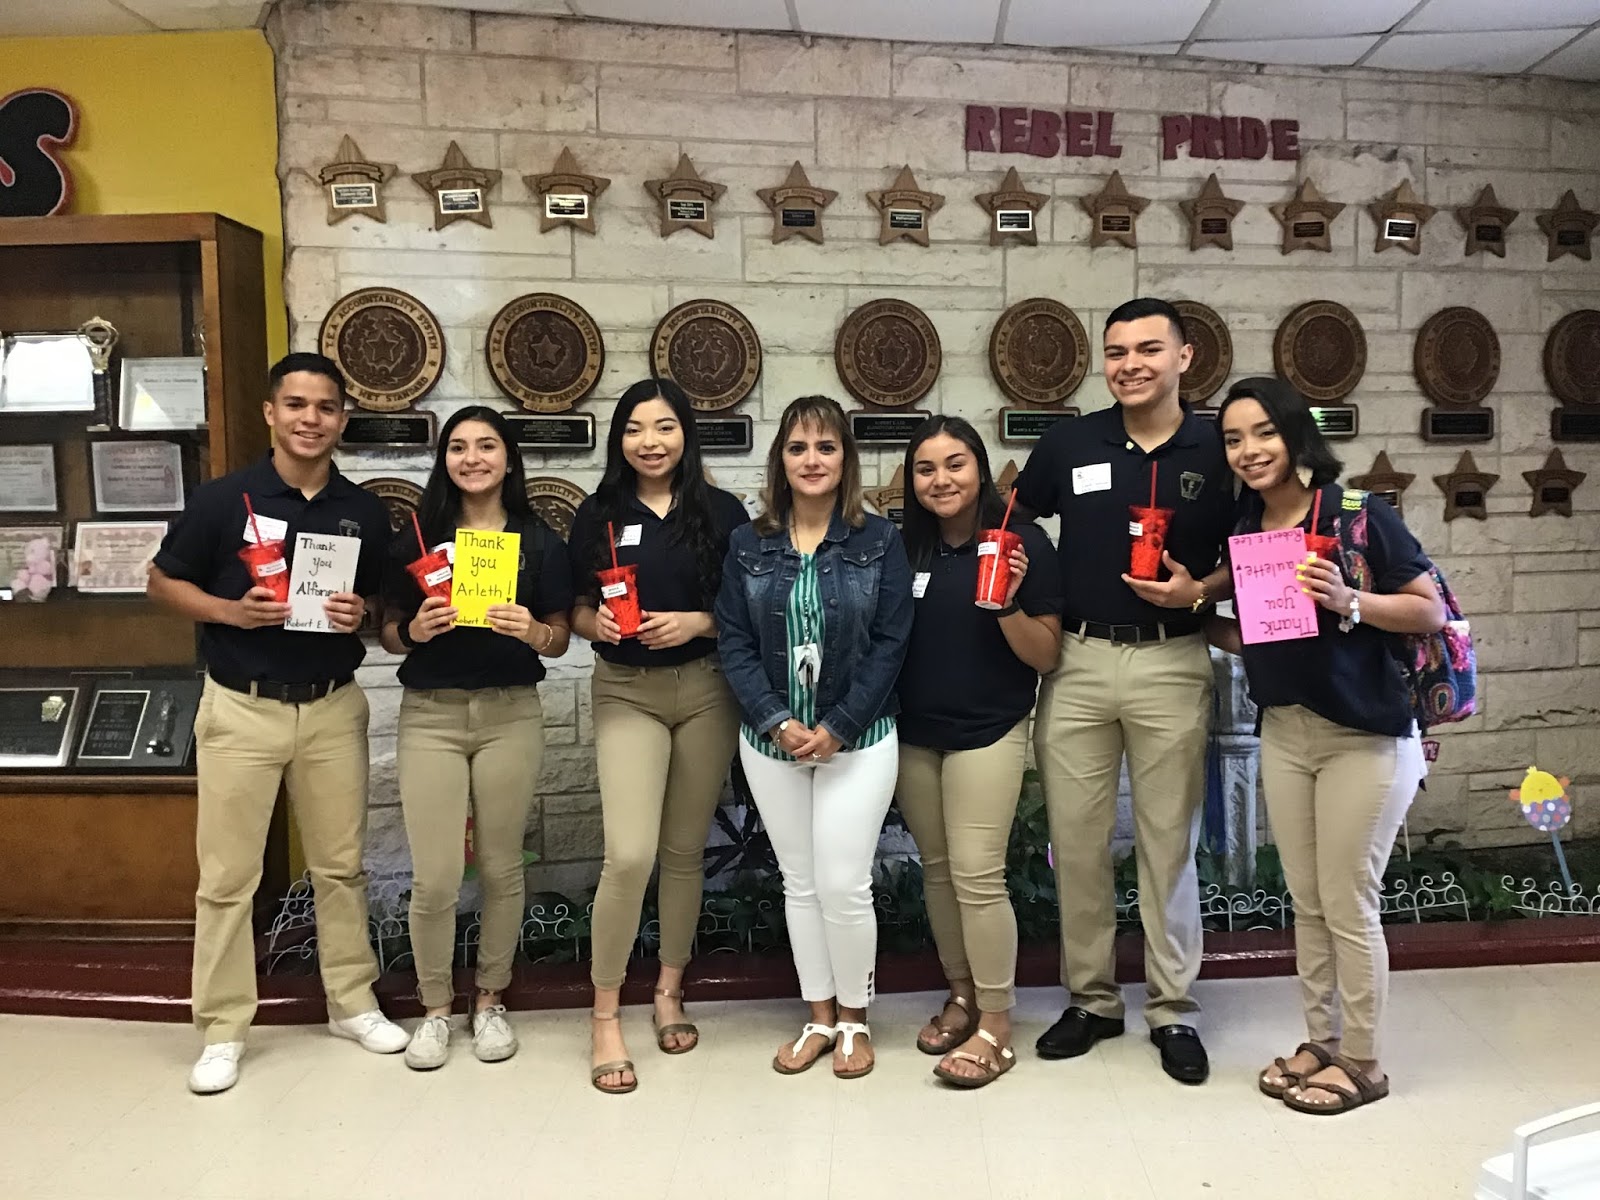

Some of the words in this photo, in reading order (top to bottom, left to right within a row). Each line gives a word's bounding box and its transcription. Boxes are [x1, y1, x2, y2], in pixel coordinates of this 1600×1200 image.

[966, 105, 1123, 158] REBEL
[1161, 114, 1300, 161] PRIDE
[416, 314, 438, 350] SYSTEM
[578, 318, 598, 355] SYSTEM
[386, 377, 429, 402] STANDARD
[549, 378, 590, 403] STANDARD
[300, 537, 337, 553] Thank
[458, 531, 505, 550] Thank
[1233, 536, 1252, 546] Lee
[1267, 529, 1302, 543] Robert
[309, 557, 332, 577] you
[470, 555, 497, 577] you
[1265, 585, 1298, 610] you
[286, 617, 313, 629] Robert
[1260, 617, 1317, 636] Thank
